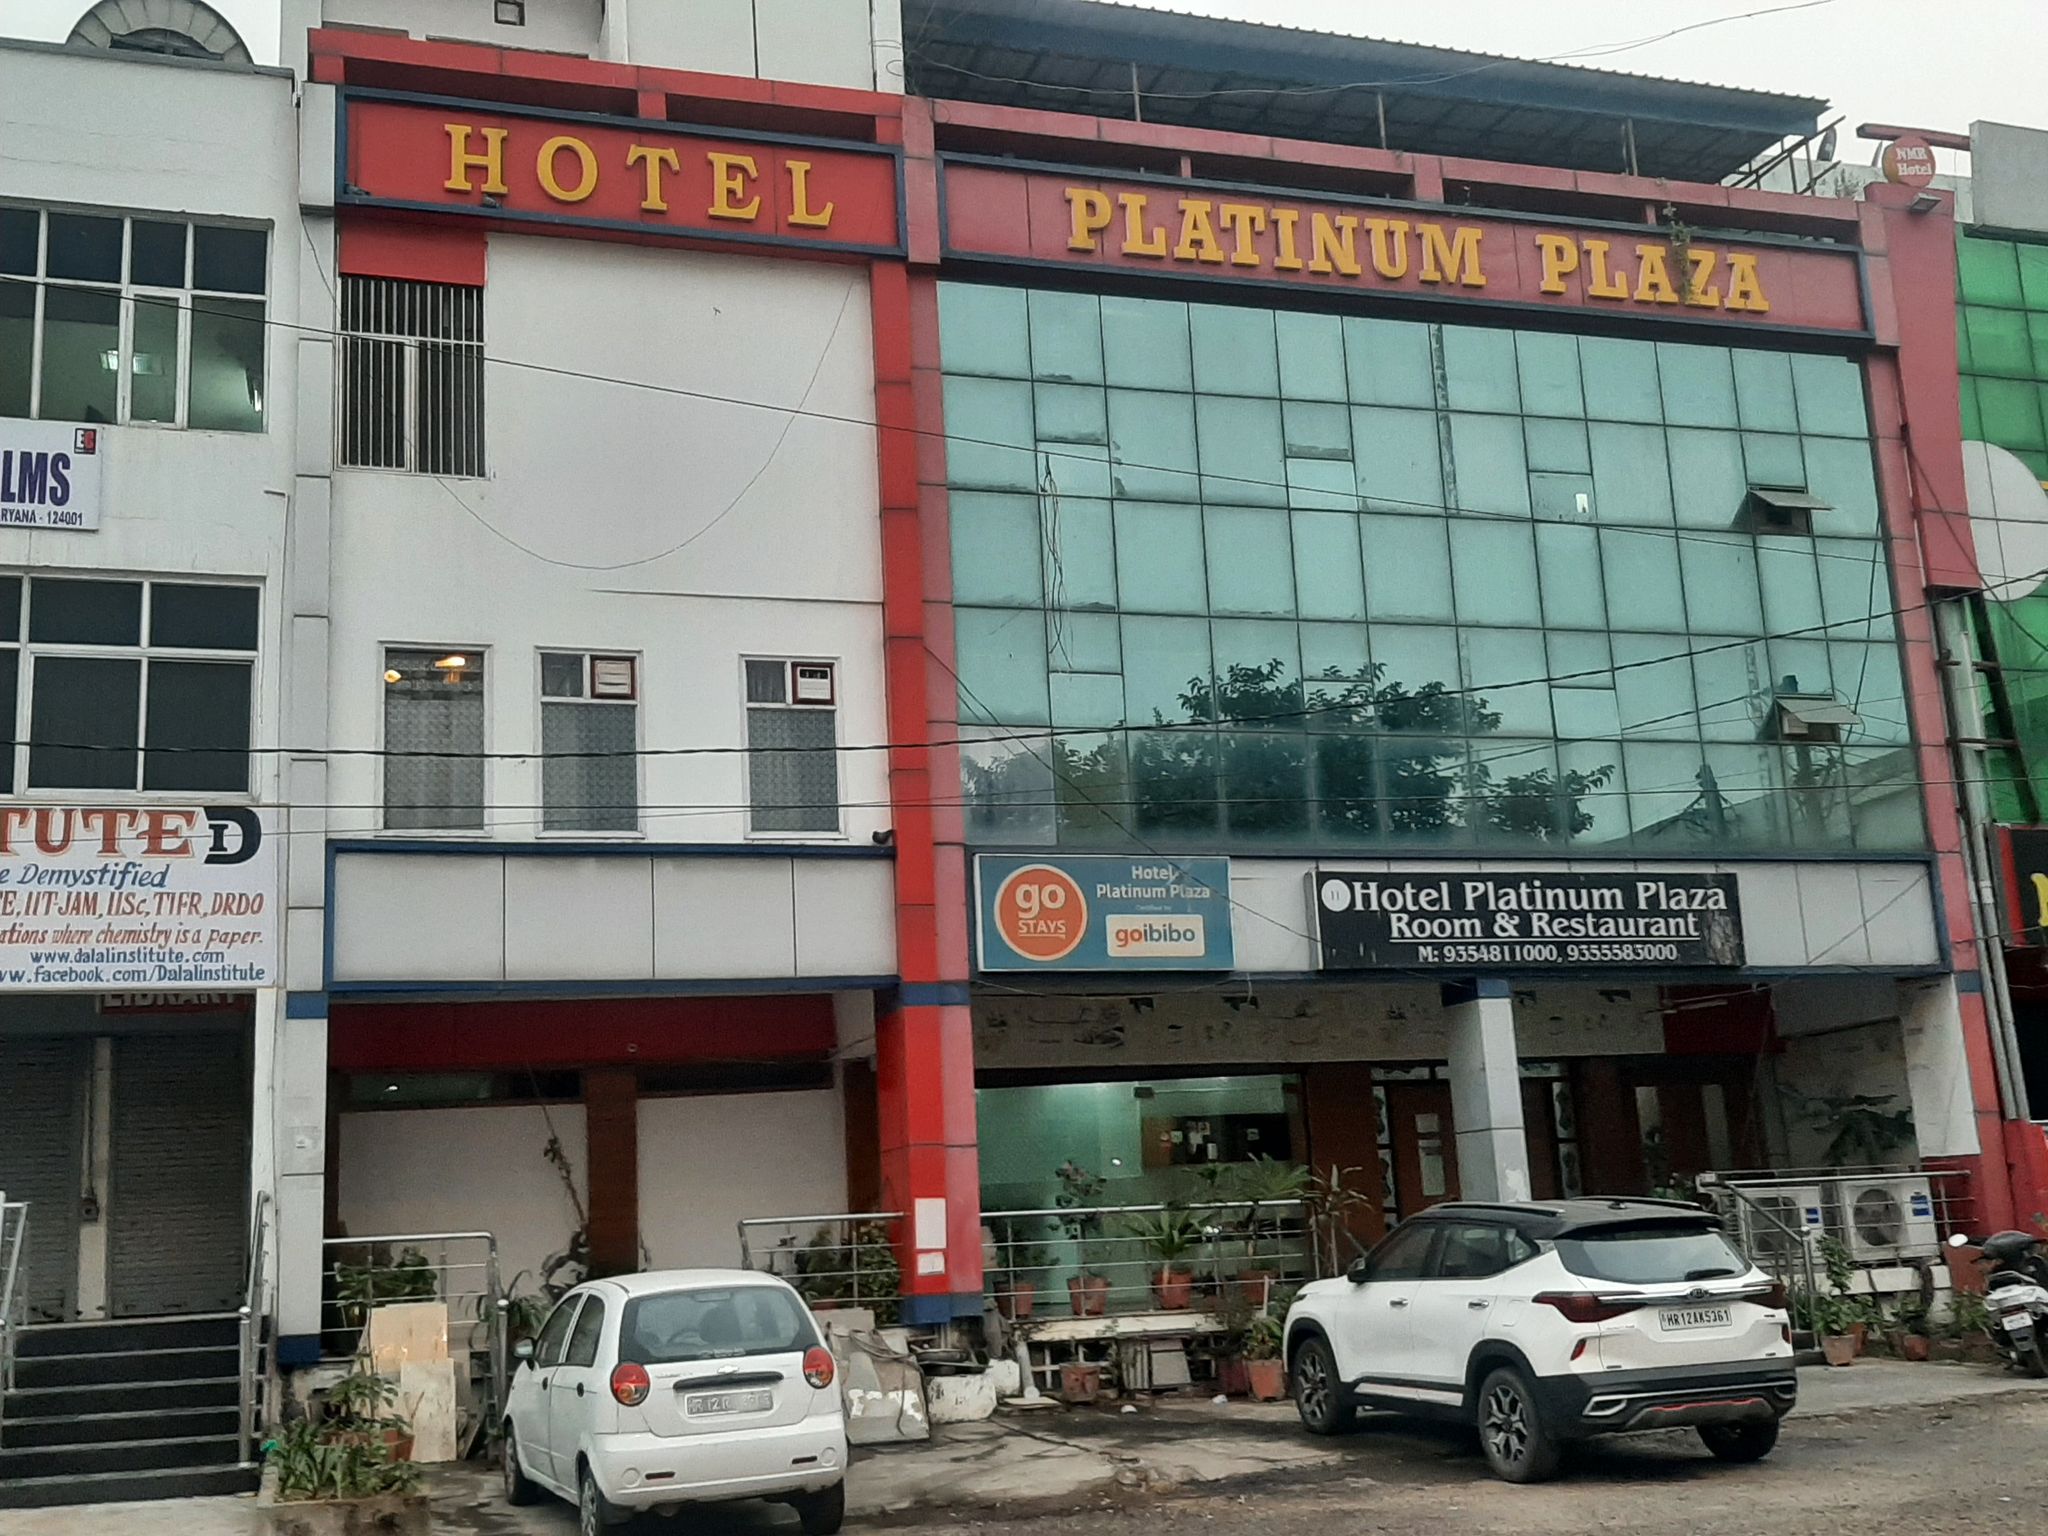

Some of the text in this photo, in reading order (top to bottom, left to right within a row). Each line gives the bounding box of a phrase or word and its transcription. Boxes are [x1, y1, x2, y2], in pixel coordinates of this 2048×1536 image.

[1897, 162, 1933, 176] Hotel
[443, 123, 1770, 312] HOTEL PLATINUM PLAZA
[1, 450, 70, 506] LMS
[47, 510, 83, 526] 124001
[17, 861, 170, 891] Demystified
[1015, 883, 1066, 919] go
[1096, 883, 1210, 898] Platinum Plaza
[1352, 880, 1728, 912] Hotel Platinum Plaza
[95, 921, 172, 950] chemistry
[205, 928, 264, 950] paper.
[1018, 919, 1067, 934] STAYS
[1115, 923, 1196, 947] goibibo
[1389, 912, 1700, 938] Room & Restaurant
[30, 946, 226, 963] www.dalalinstitute.com
[1418, 945, 1440, 963] M:
